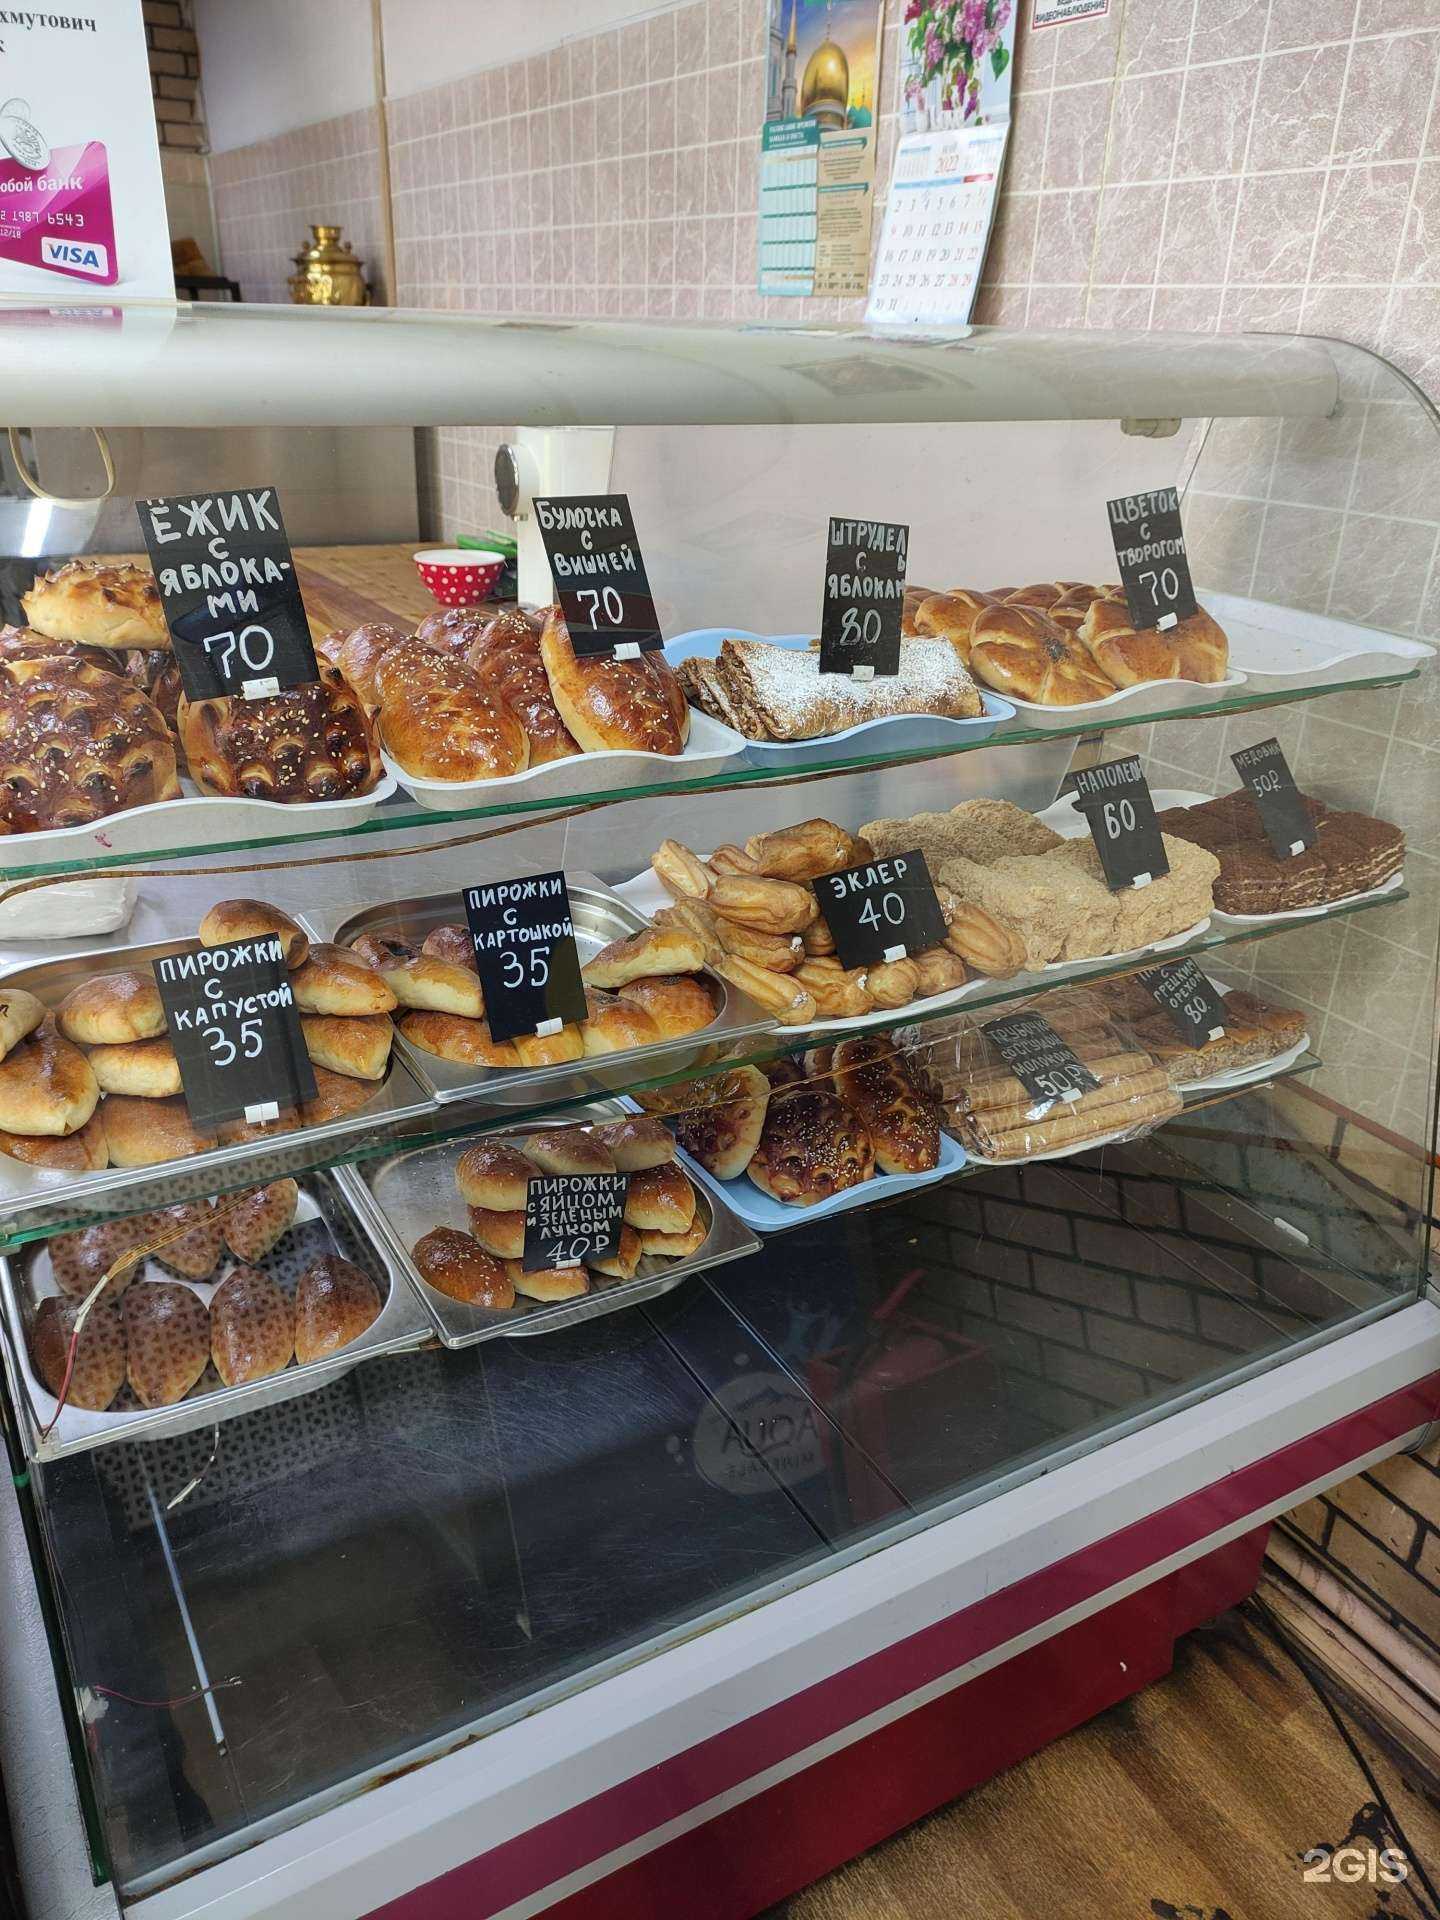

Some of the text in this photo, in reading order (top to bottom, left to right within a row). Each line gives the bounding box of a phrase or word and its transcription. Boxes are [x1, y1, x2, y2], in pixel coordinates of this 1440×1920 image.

[37, 175, 83, 191] банк
[13, 211, 39, 223] 1987
[48, 213, 84, 227] 6543
[48, 243, 99, 267] VISA
[147, 490, 279, 544] ЁЖИК
[1110, 491, 1178, 524] ЦВЕТОК
[1117, 536, 1186, 567] ТВОРОГОМ
[159, 557, 290, 597] ЯБЛОКА-
[1138, 568, 1179, 606] 70
[207, 589, 260, 618] МИ
[577, 586, 624, 631] 70
[839, 607, 882, 646] 80
[203, 624, 274, 679] 70
[469, 878, 562, 909] ПИРОЖКИ
[829, 858, 907, 899] ЭКЛЕР
[858, 892, 905, 931] 40
[473, 917, 574, 951] КАРТОШКОЙ
[159, 940, 283, 982] ПИРОЖКИ
[499, 946, 550, 988] 35
[174, 982, 293, 1031] КАПУСТОЙ
[202, 1018, 263, 1066] 35
[530, 1176, 626, 1195] ПИРОЖКИ
[540, 1192, 615, 1212] ЯЙЦОМ
[540, 1219, 610, 1240] ЛУКОМ
